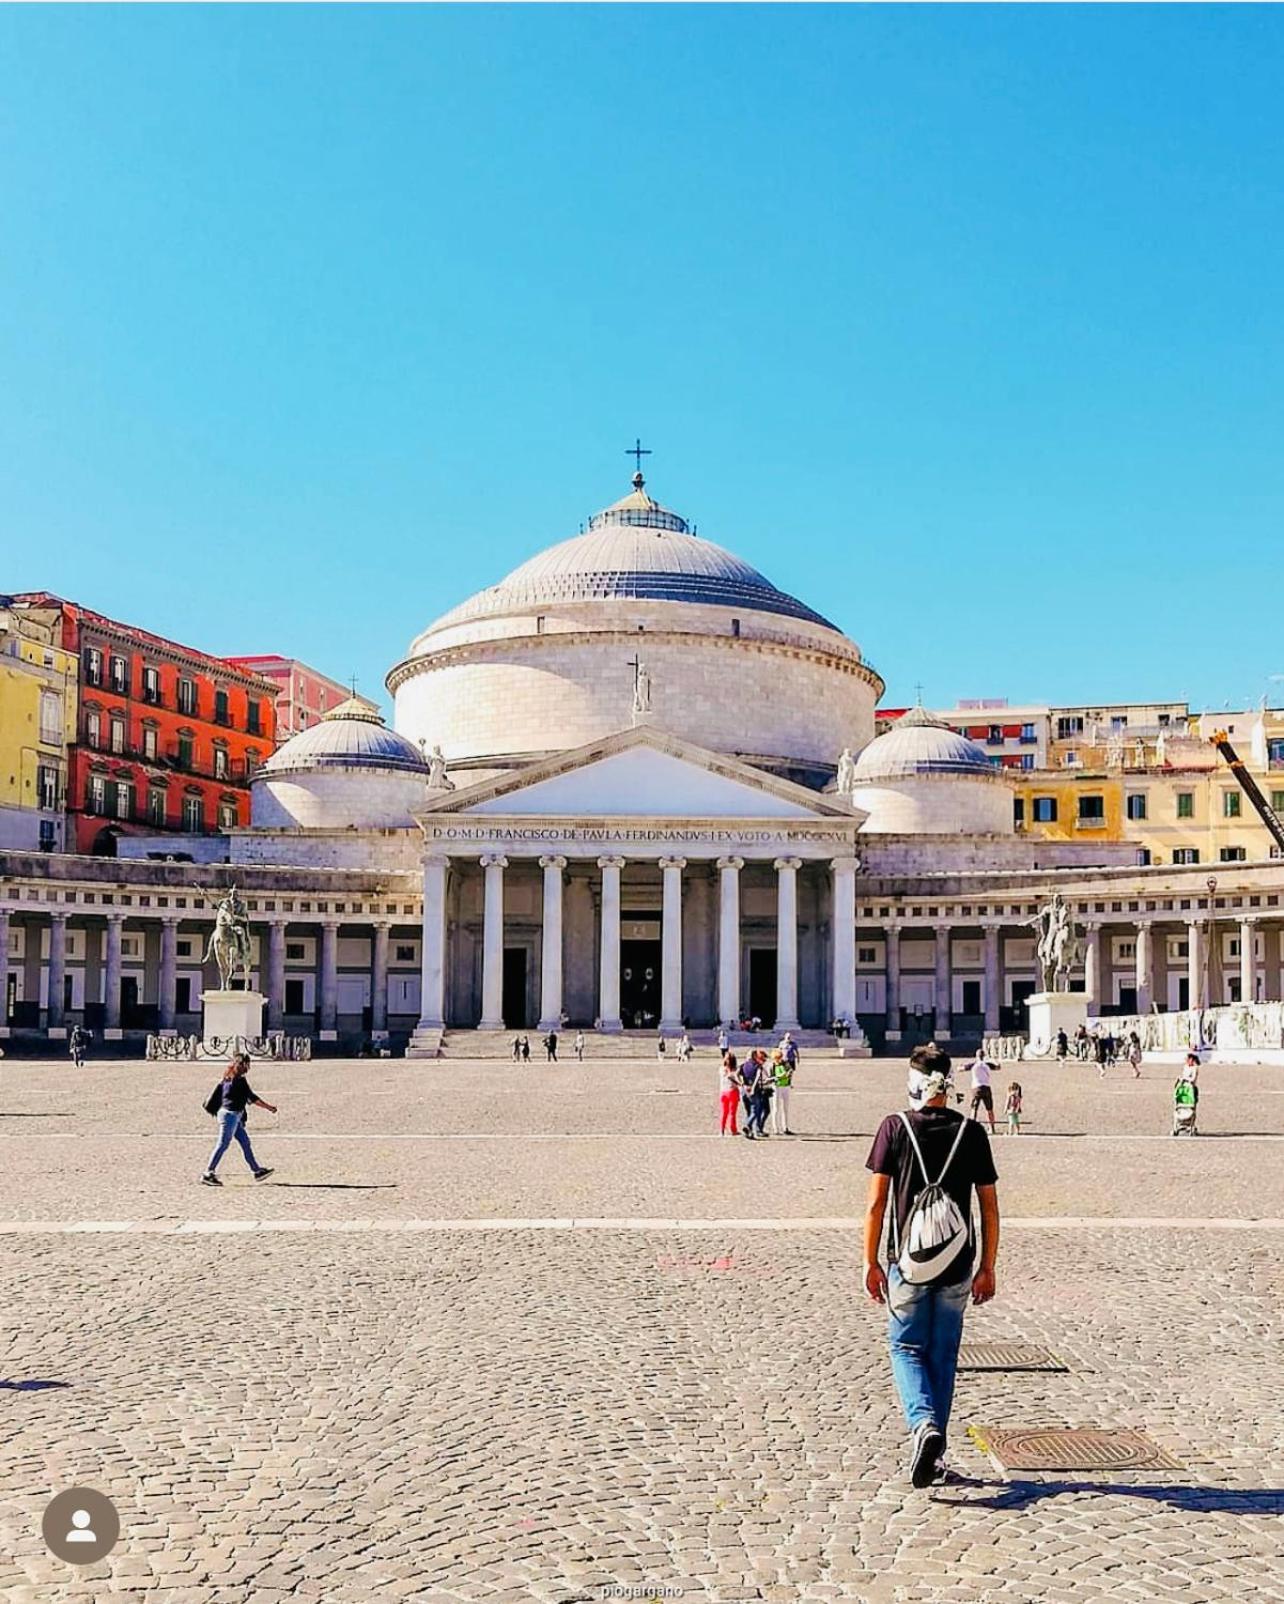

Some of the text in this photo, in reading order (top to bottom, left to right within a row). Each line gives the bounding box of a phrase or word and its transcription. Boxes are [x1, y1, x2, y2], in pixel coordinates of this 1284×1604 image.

[489, 828, 559, 840] FRANCISCO
[563, 829, 577, 840] DE
[583, 829, 622, 840] PAVLA
[626, 830, 708, 840] FERDINANDVS
